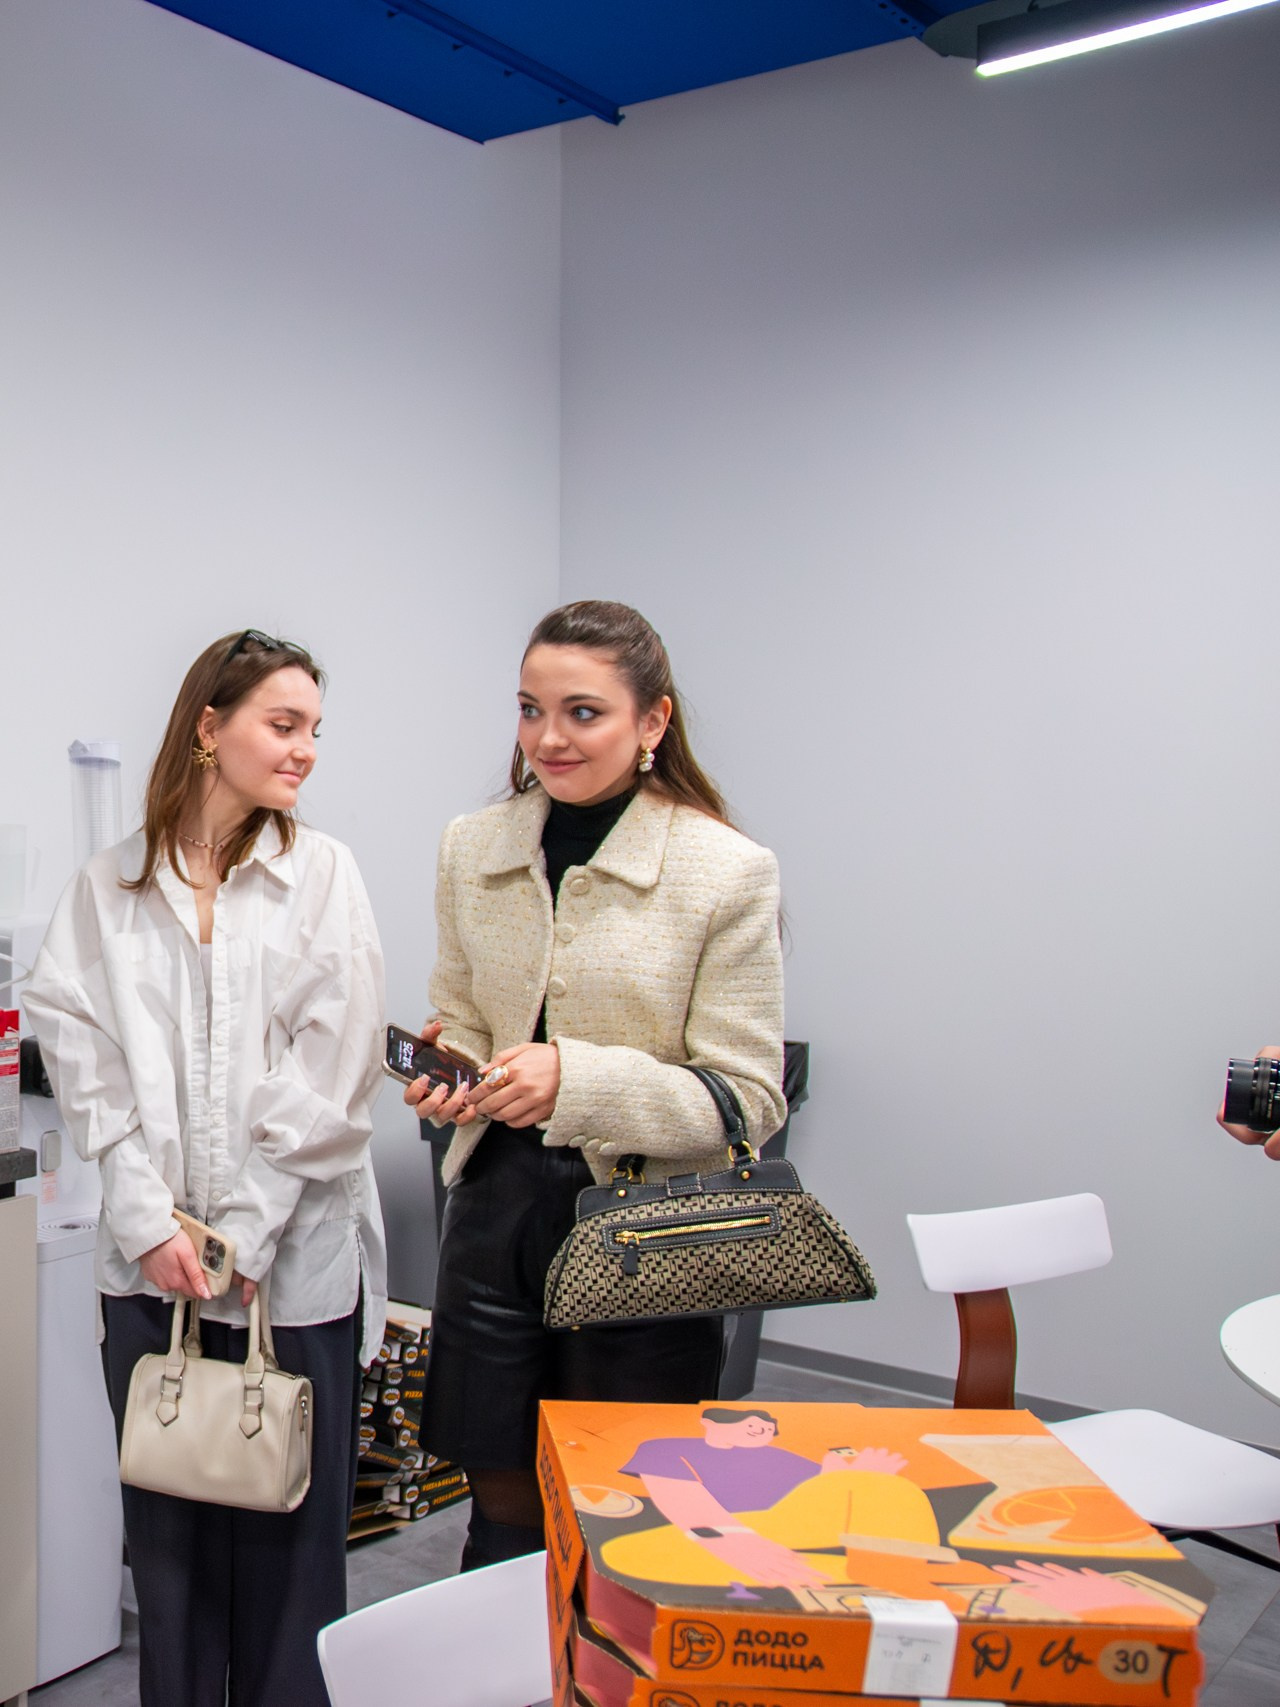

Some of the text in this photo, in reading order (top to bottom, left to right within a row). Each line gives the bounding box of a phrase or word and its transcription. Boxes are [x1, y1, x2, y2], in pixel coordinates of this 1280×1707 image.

[733, 1628, 810, 1648] ДОДО
[732, 1651, 825, 1673] ПИЦЦА
[1113, 1650, 1150, 1674] 30
